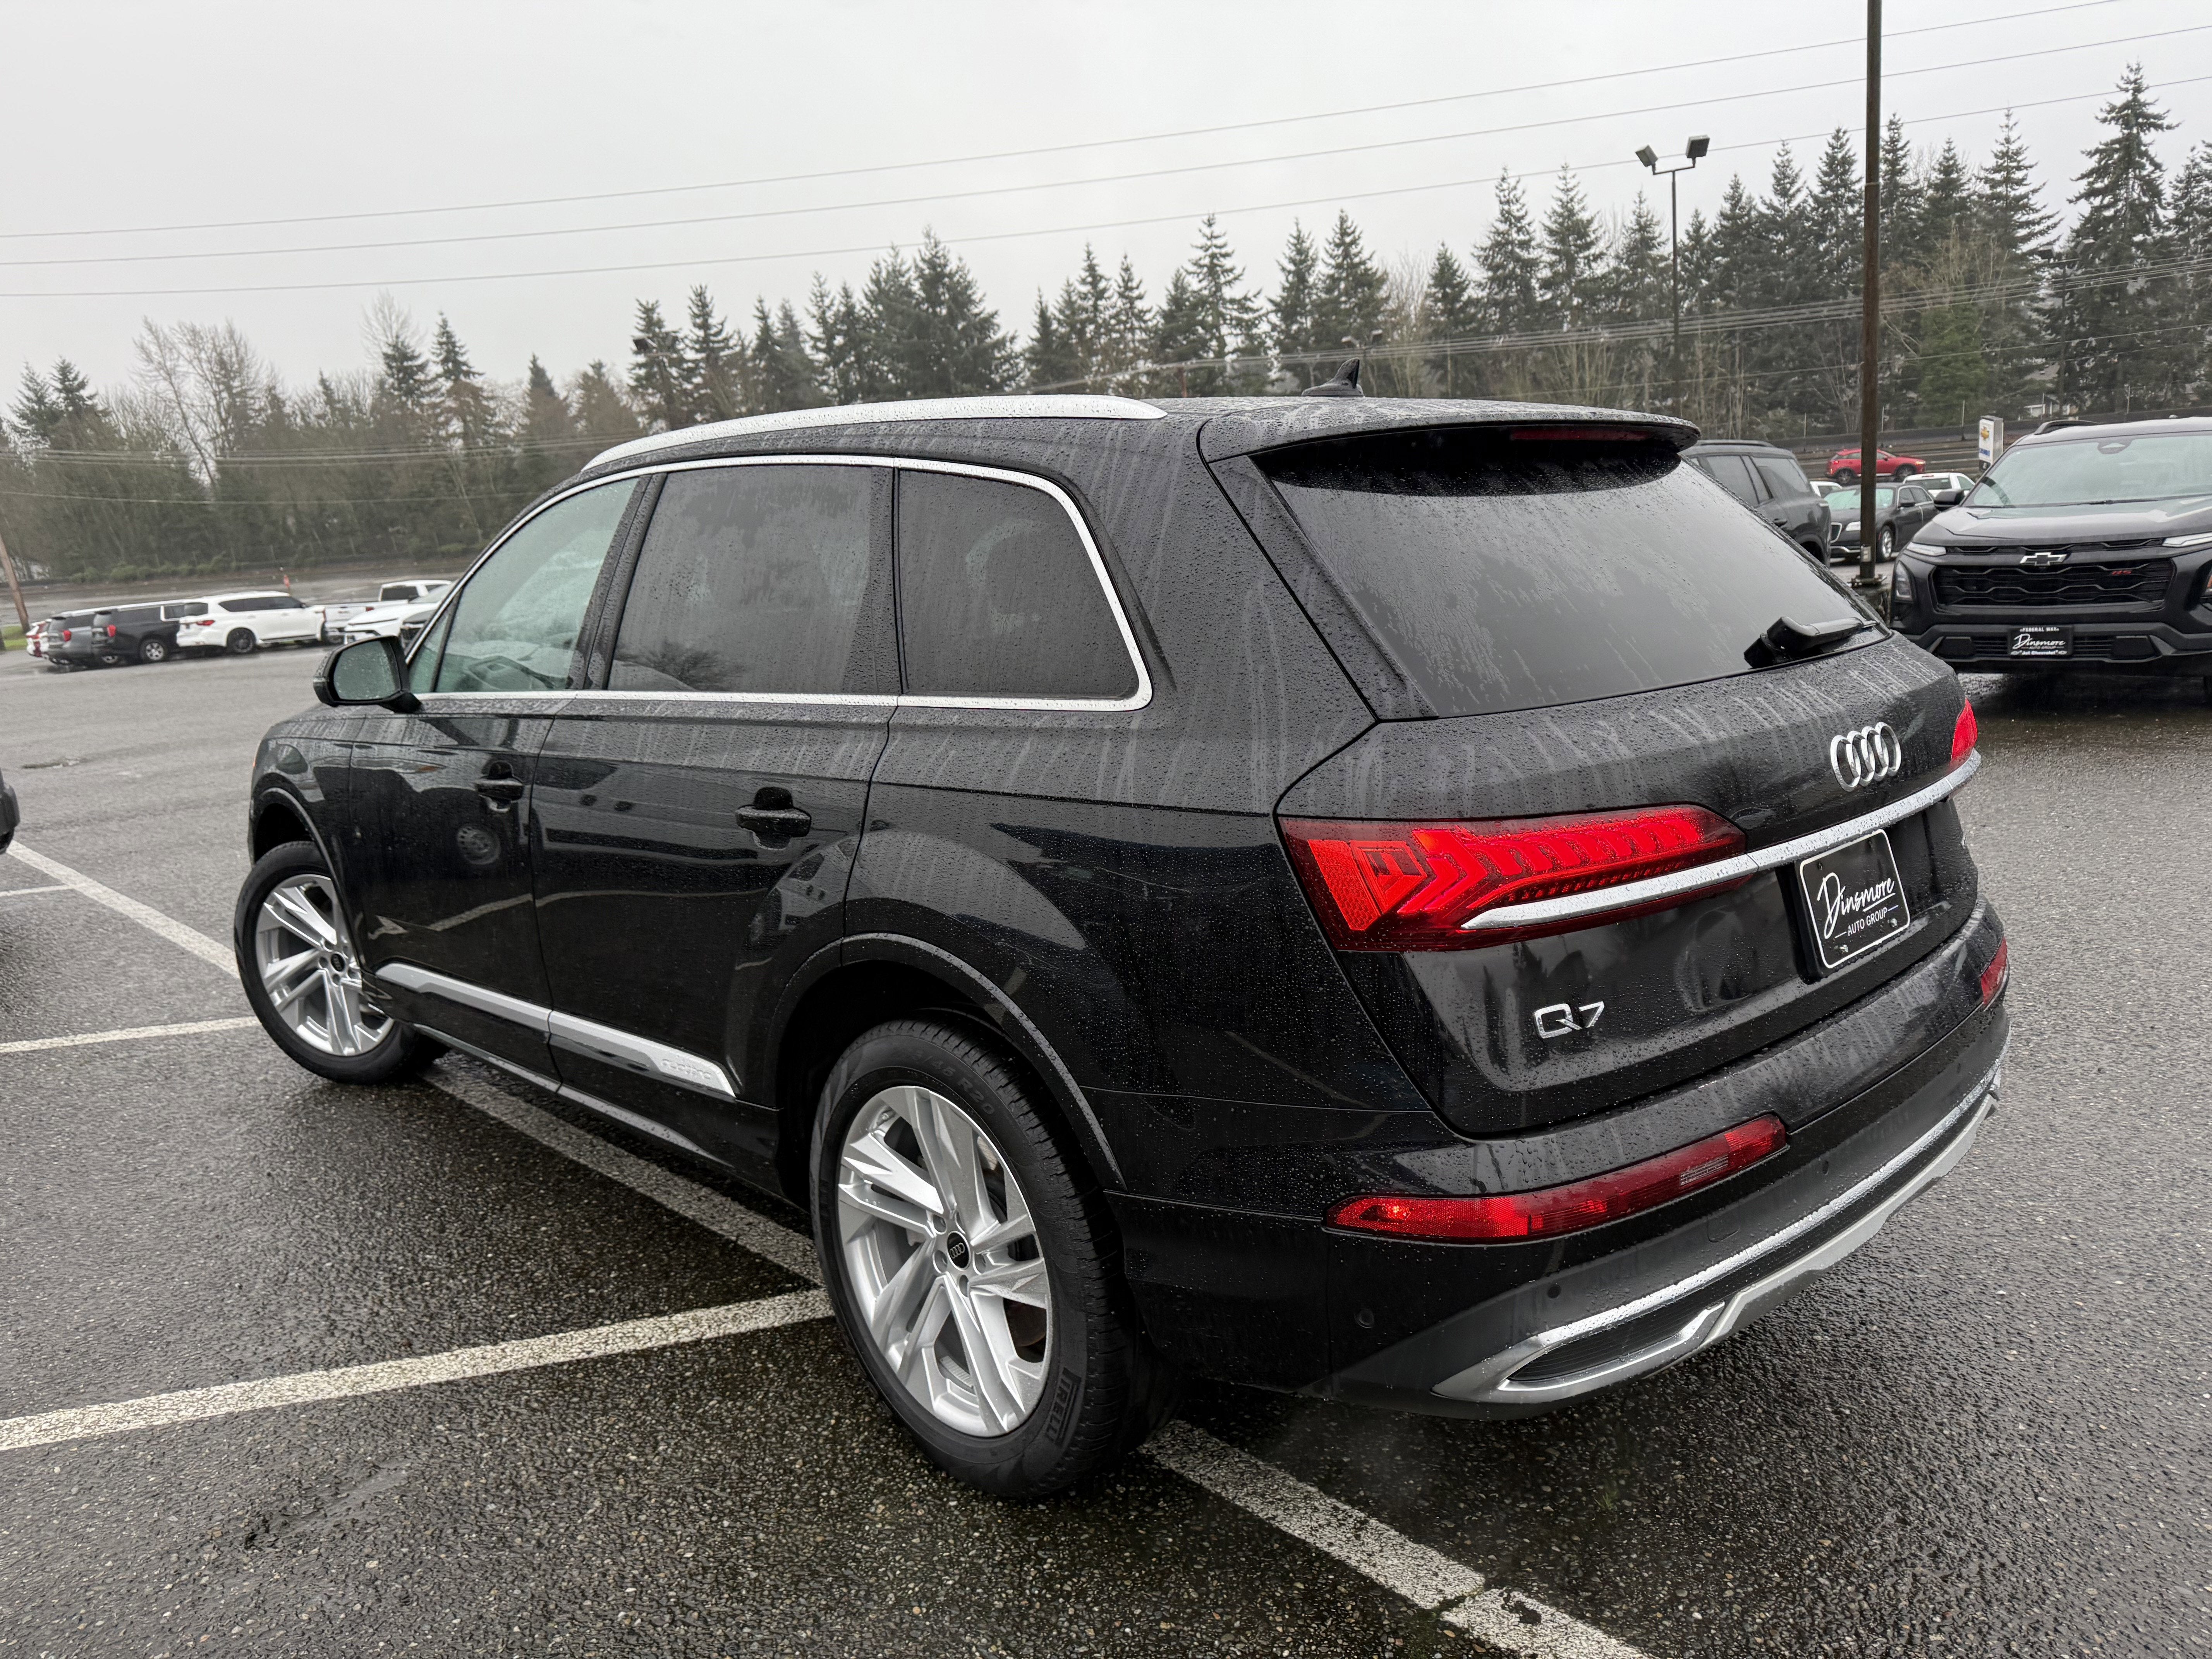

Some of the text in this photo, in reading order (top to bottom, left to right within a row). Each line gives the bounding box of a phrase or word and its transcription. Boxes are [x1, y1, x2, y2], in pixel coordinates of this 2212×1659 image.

[2012, 633, 2066, 649] Dinsmore
[1817, 872, 1895, 939] Dinsmore
[1848, 907, 1887, 936] AUTO GROUP
[1535, 1001, 1605, 1039] Q7
[957, 1077, 995, 1115] R20
